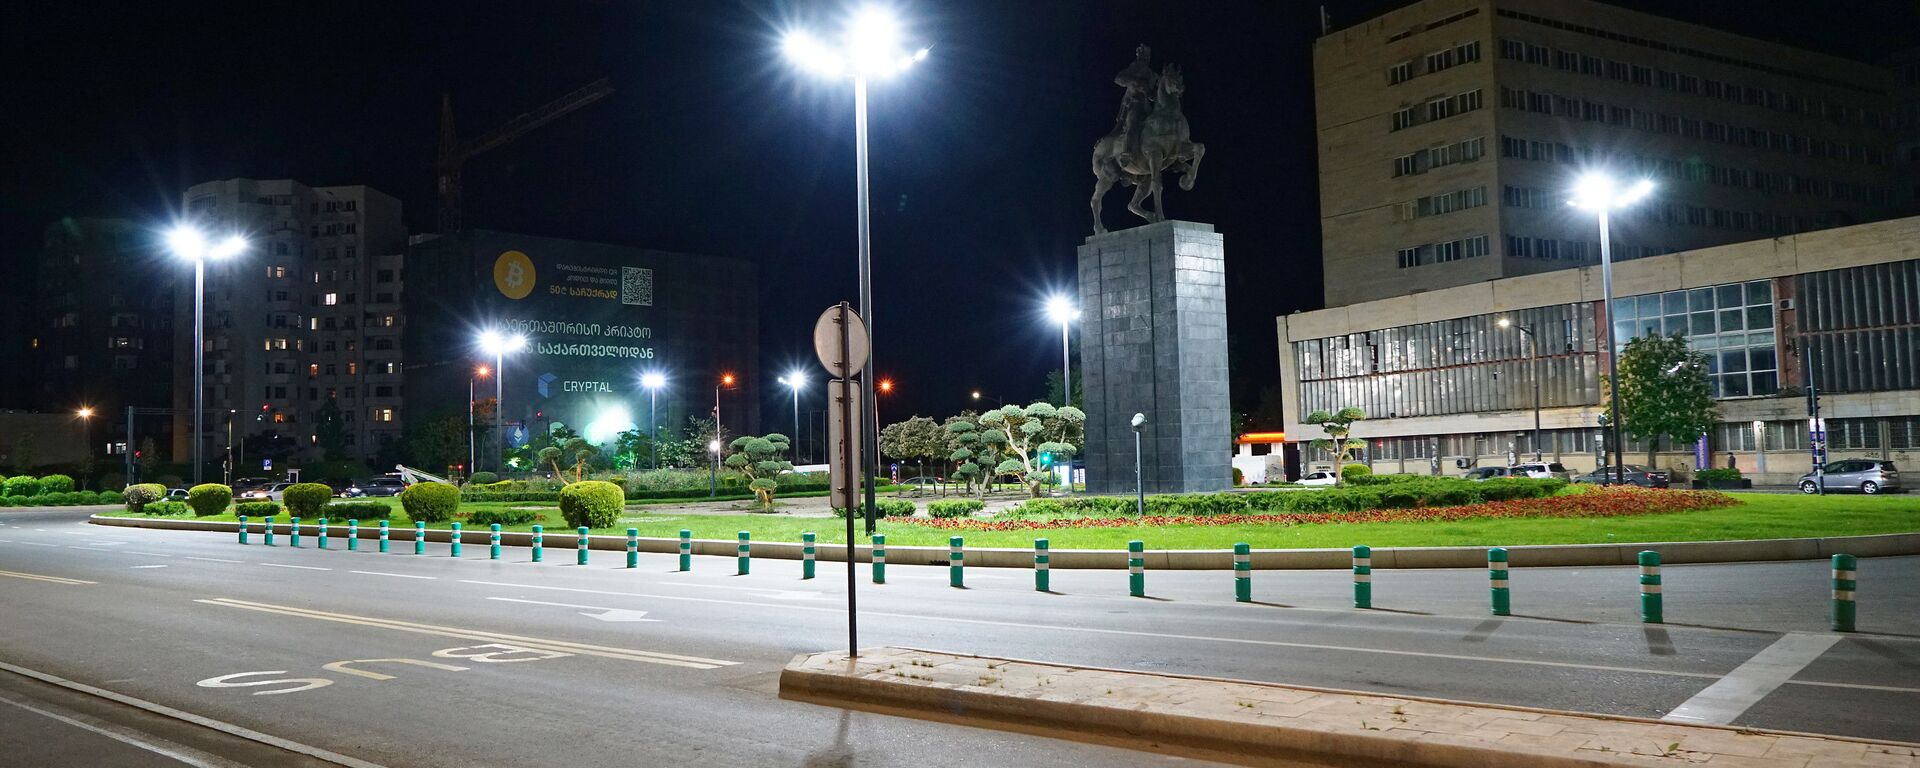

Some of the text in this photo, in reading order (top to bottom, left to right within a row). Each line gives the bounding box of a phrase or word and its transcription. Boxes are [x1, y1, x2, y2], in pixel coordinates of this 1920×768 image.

[569, 286, 618, 299] საჩუქრად
[604, 325, 652, 340] კრიპტო
[537, 342, 654, 360] საქართველოდან
[563, 380, 613, 393] CRYPTAL
[195, 642, 579, 696] BUS
